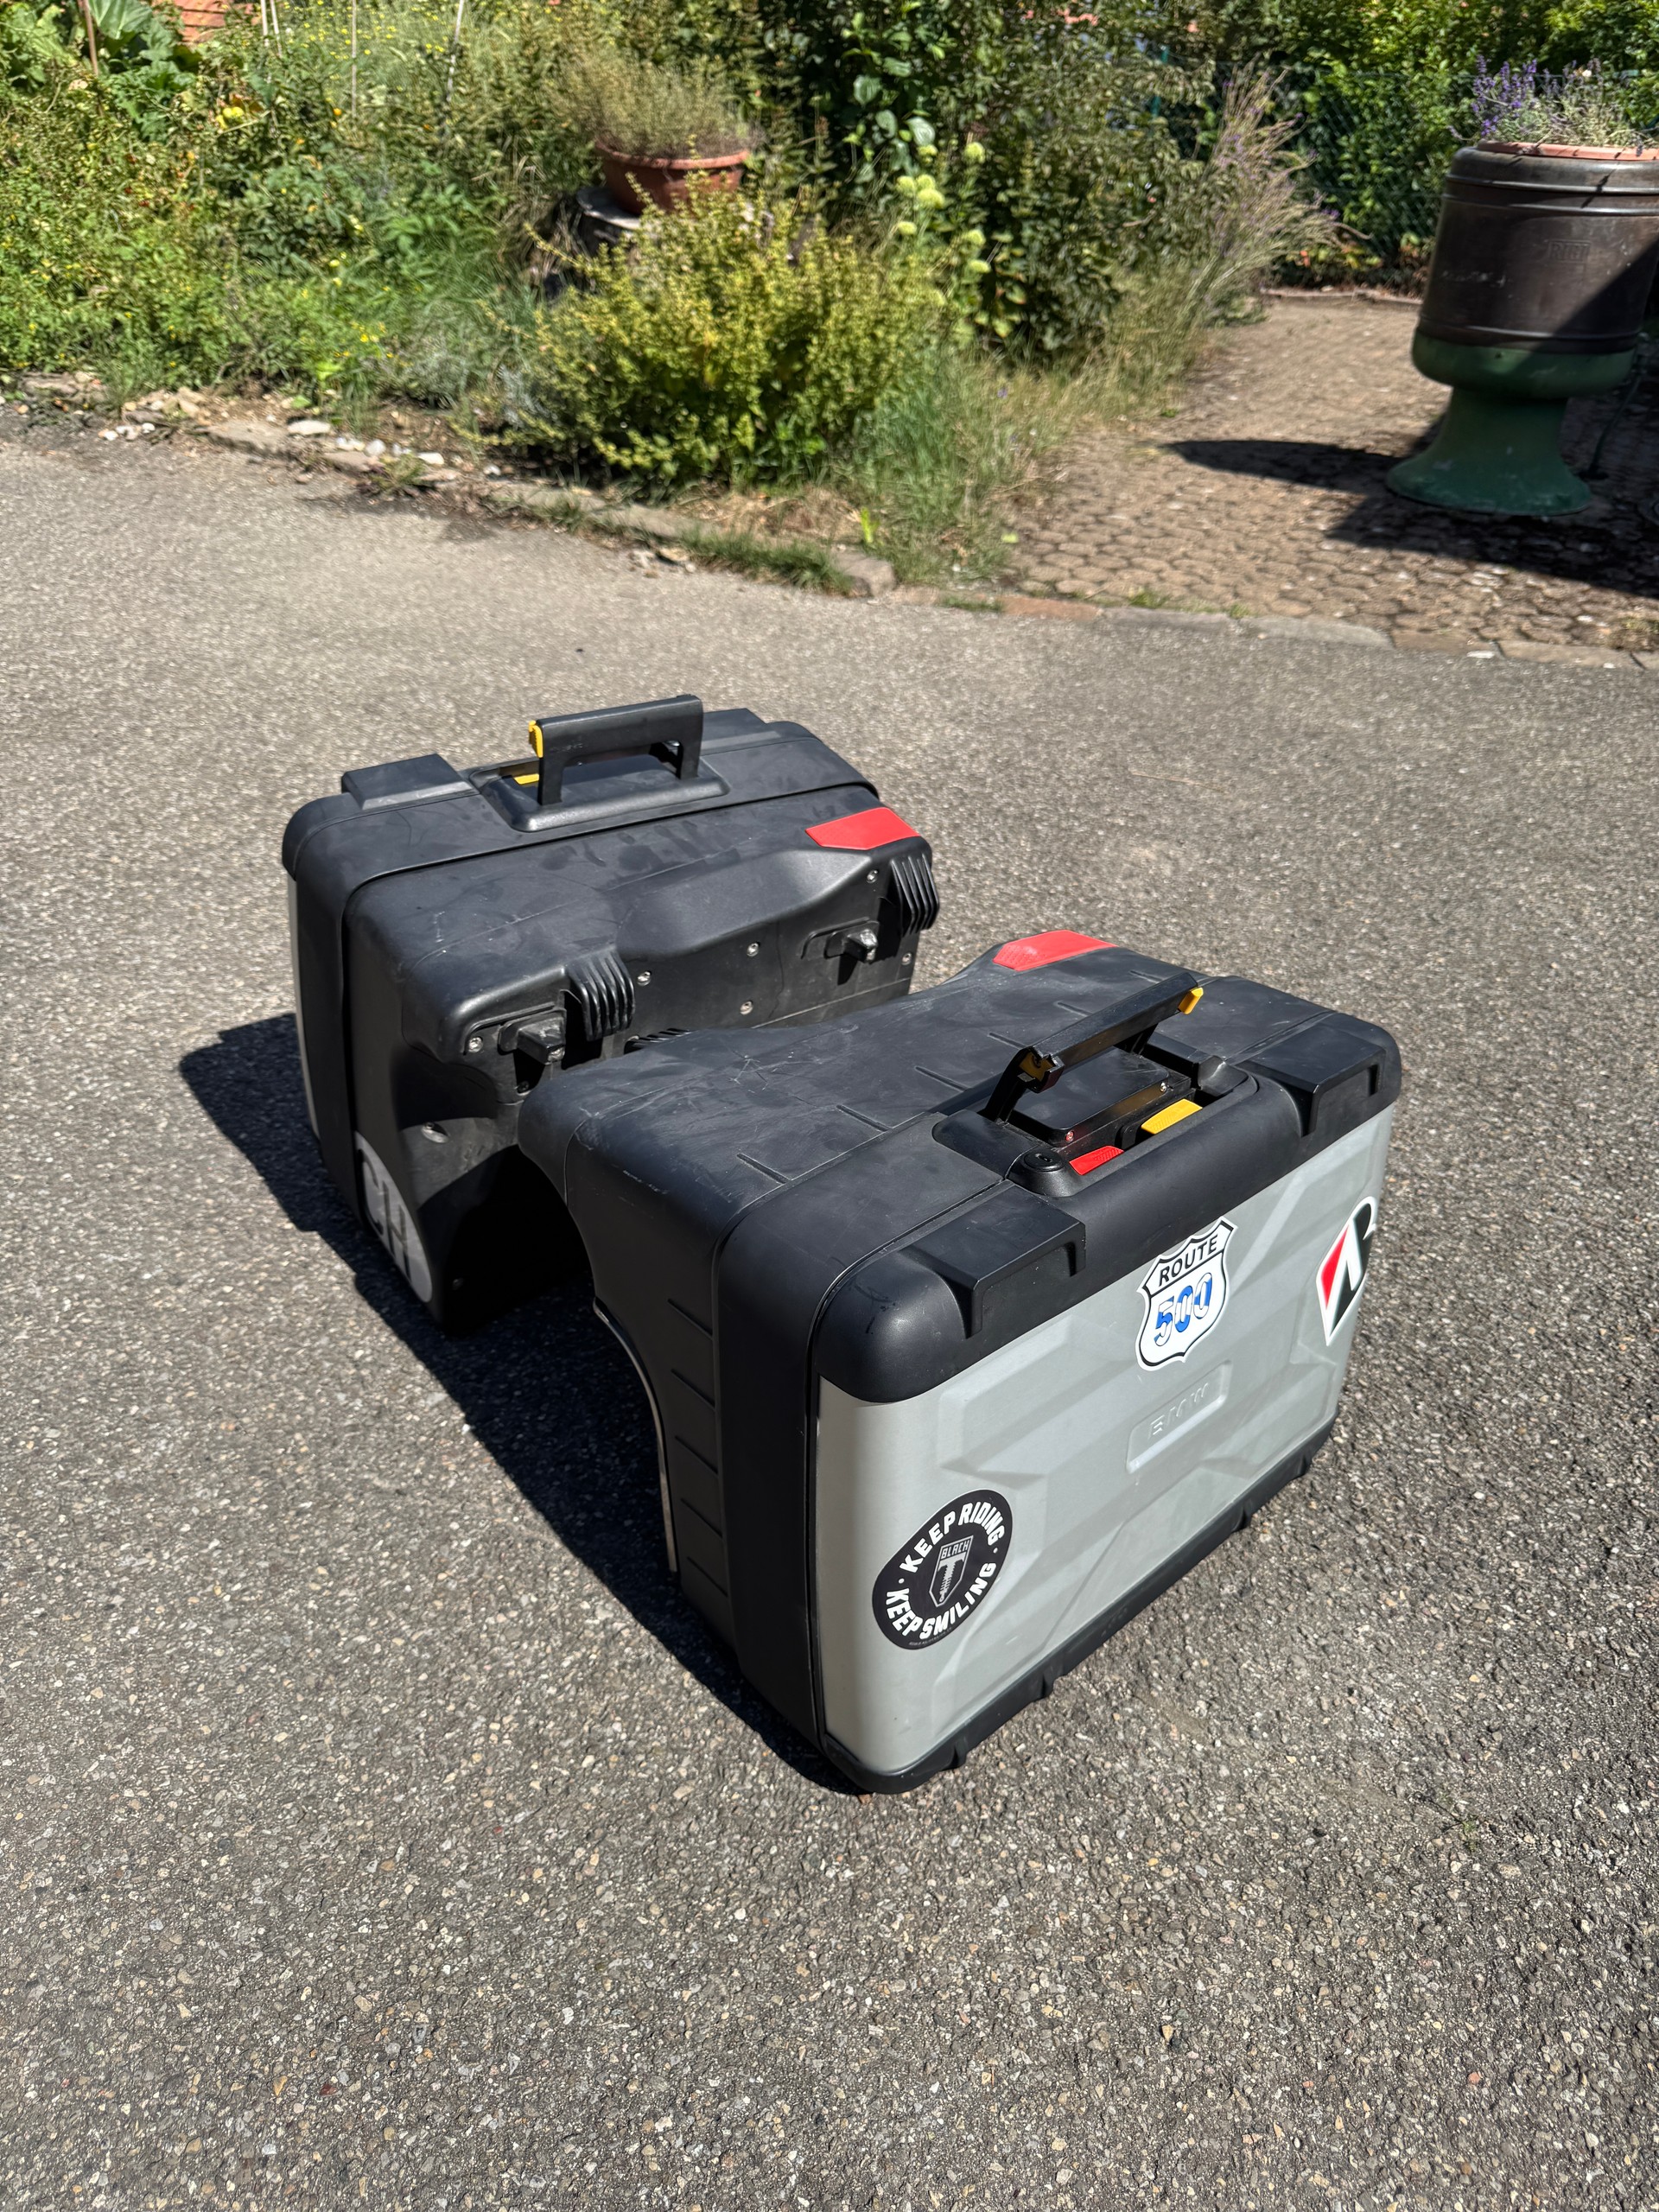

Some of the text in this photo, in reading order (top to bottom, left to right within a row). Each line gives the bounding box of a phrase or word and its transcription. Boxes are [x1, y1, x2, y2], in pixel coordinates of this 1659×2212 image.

[1159, 1234, 1218, 1287] ROUTE
[1154, 1272, 1213, 1347] 500
[899, 1501, 1005, 1573] KEEP RIDING
[886, 1562, 996, 1639] KEEP SMILING
